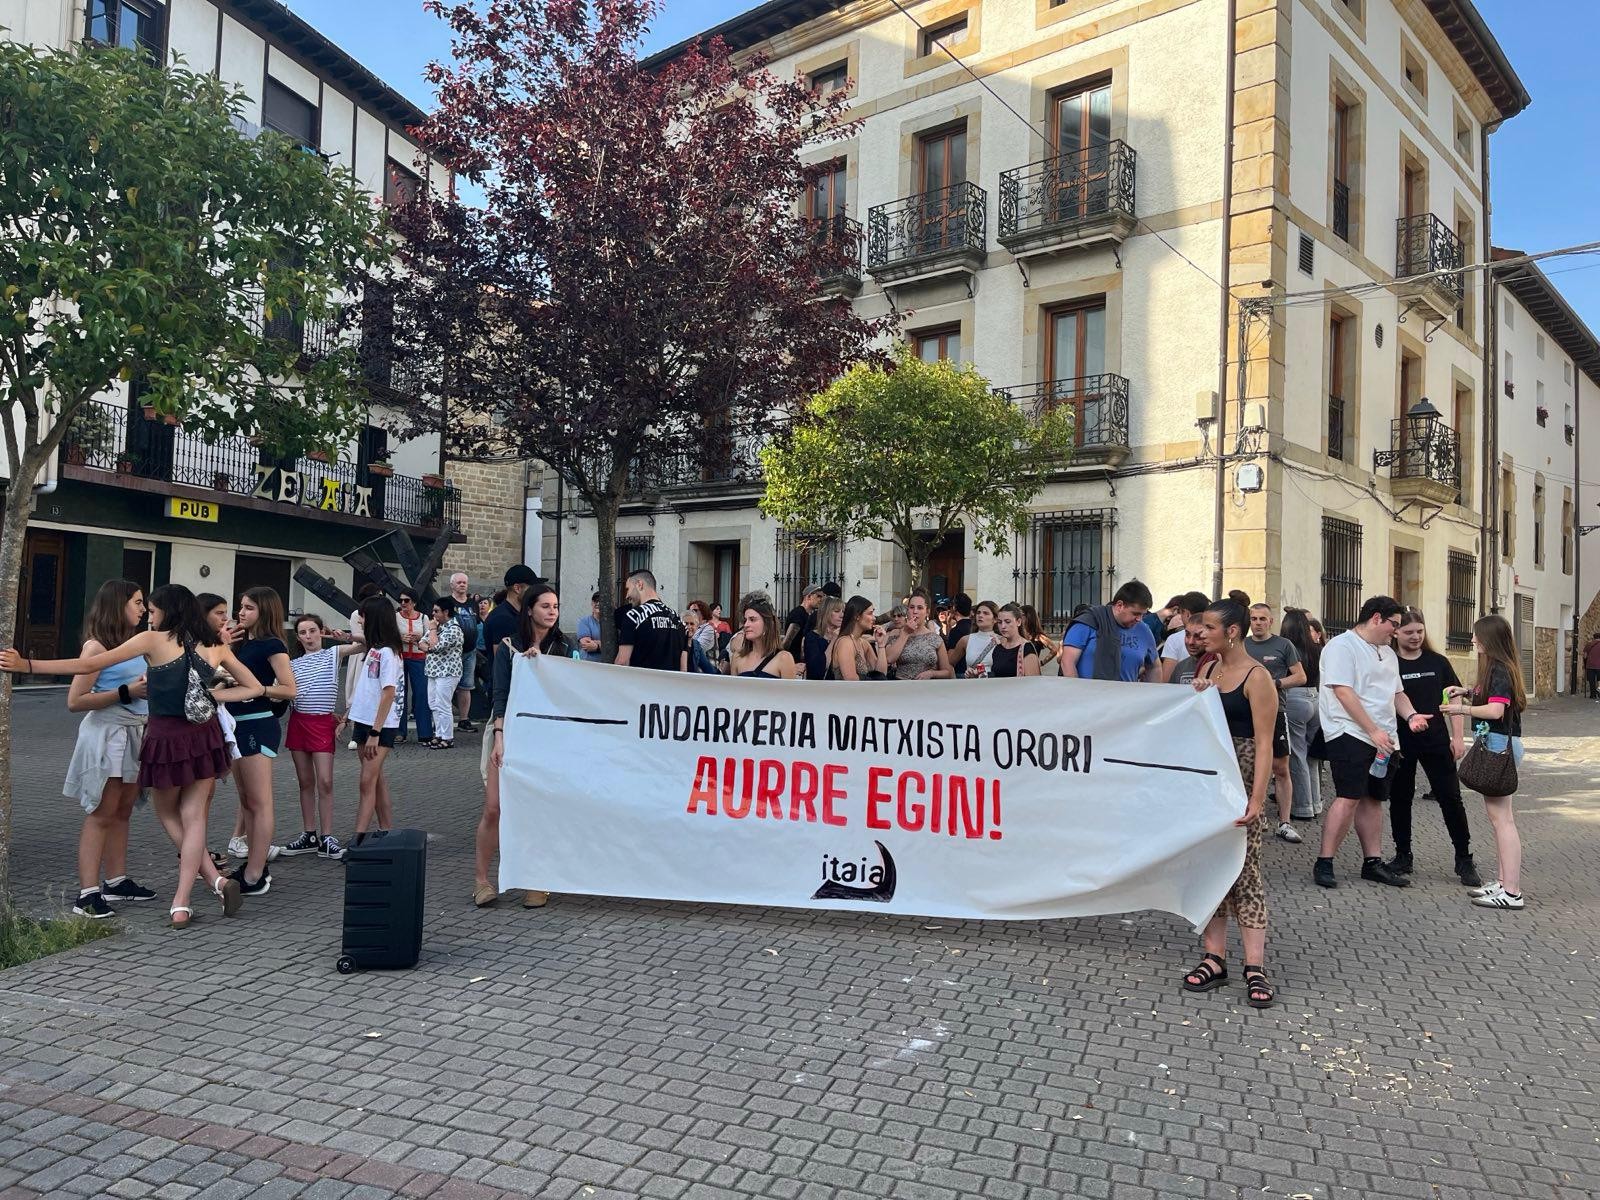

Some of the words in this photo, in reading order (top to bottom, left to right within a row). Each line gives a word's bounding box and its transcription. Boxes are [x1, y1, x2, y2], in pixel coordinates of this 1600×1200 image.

[52, 506, 59, 515] 13
[179, 502, 210, 519] PUB
[639, 703, 816, 749] INDARKERIA
[828, 713, 981, 762] MATXISTA
[993, 728, 1092, 773] ORORI
[687, 755, 849, 827] AURRE
[866, 766, 1003, 840] EGIN!
[822, 854, 884, 885] itaia
